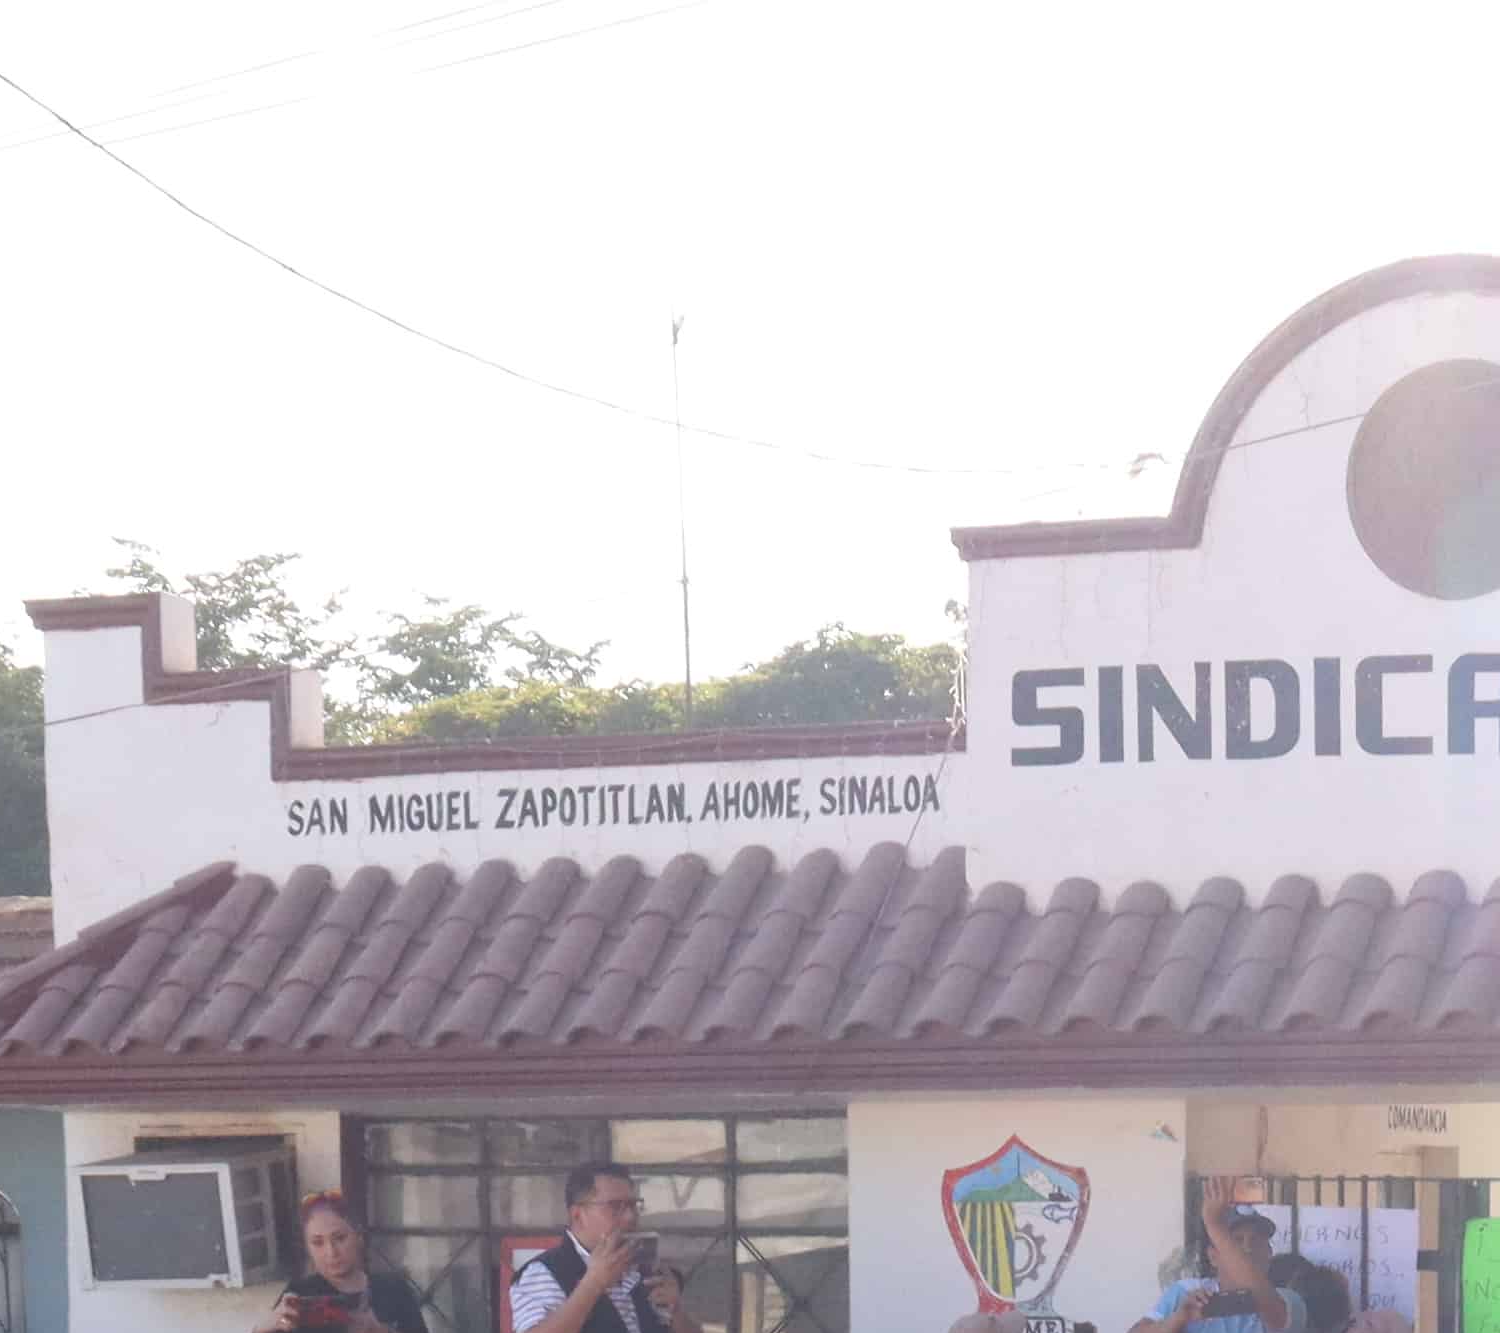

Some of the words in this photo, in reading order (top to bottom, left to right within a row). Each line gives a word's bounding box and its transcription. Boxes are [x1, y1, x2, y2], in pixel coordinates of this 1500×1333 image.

[287, 797, 348, 837] SAN
[368, 791, 480, 834] MIGUEL
[699, 778, 810, 822] AHOME,
[819, 774, 940, 816] SINALOA
